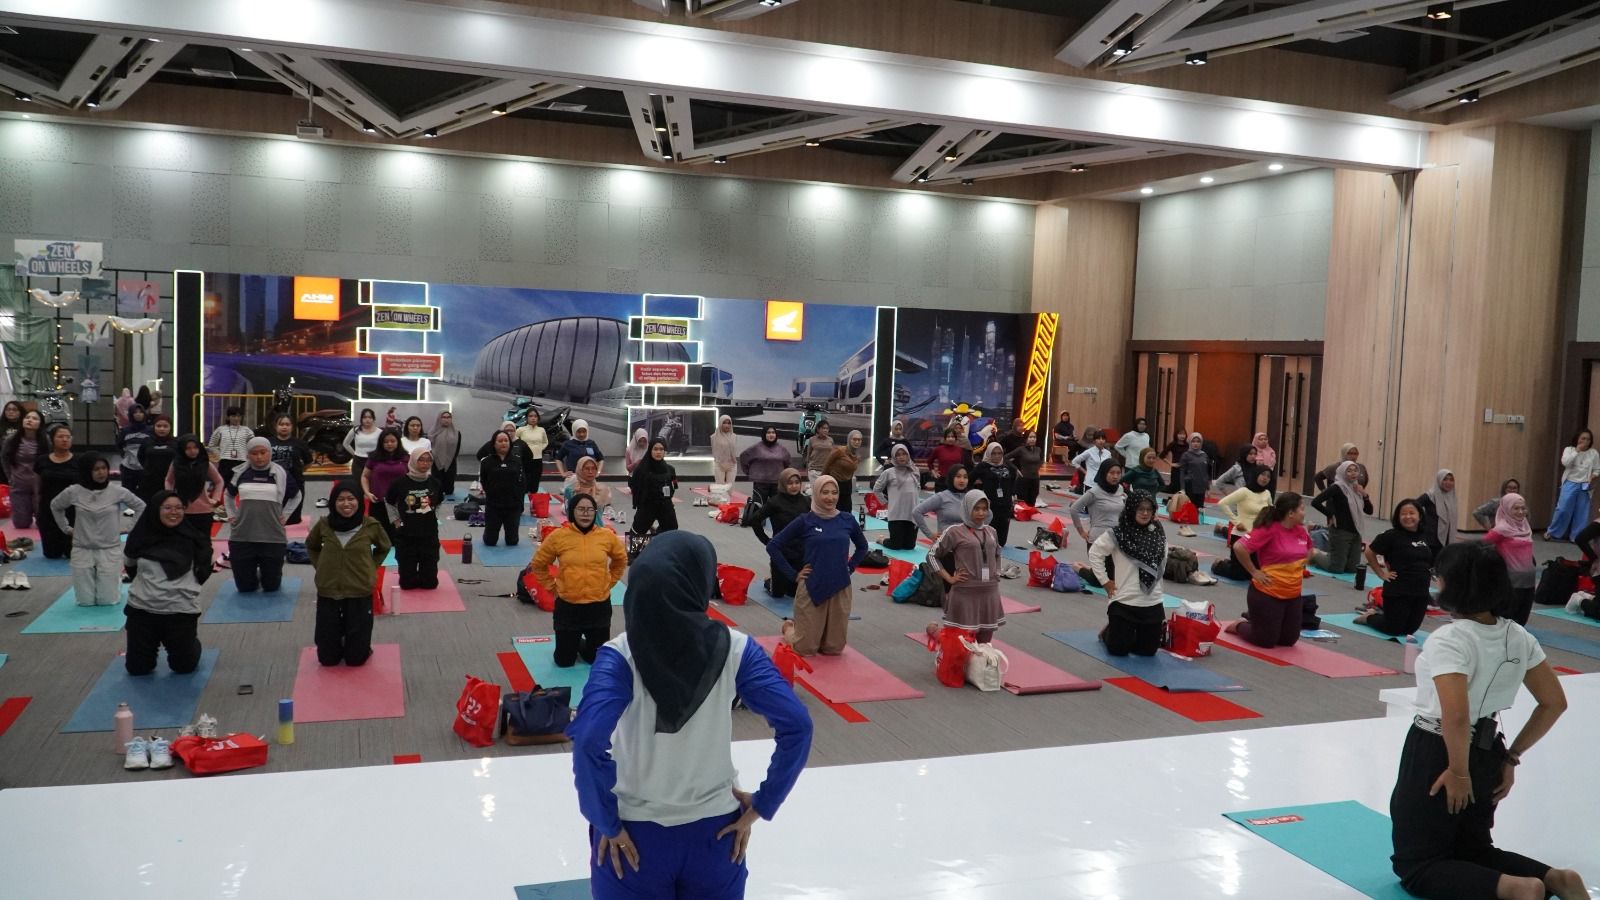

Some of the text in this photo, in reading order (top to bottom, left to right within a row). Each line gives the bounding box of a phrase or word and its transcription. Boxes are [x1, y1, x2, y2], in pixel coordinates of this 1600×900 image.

[51, 244, 71, 257] ZEN
[31, 260, 89, 273] ON WHEELS
[376, 312, 429, 323] ZEN ON WHEELS
[645, 324, 687, 336] ZEN ON WHEELS
